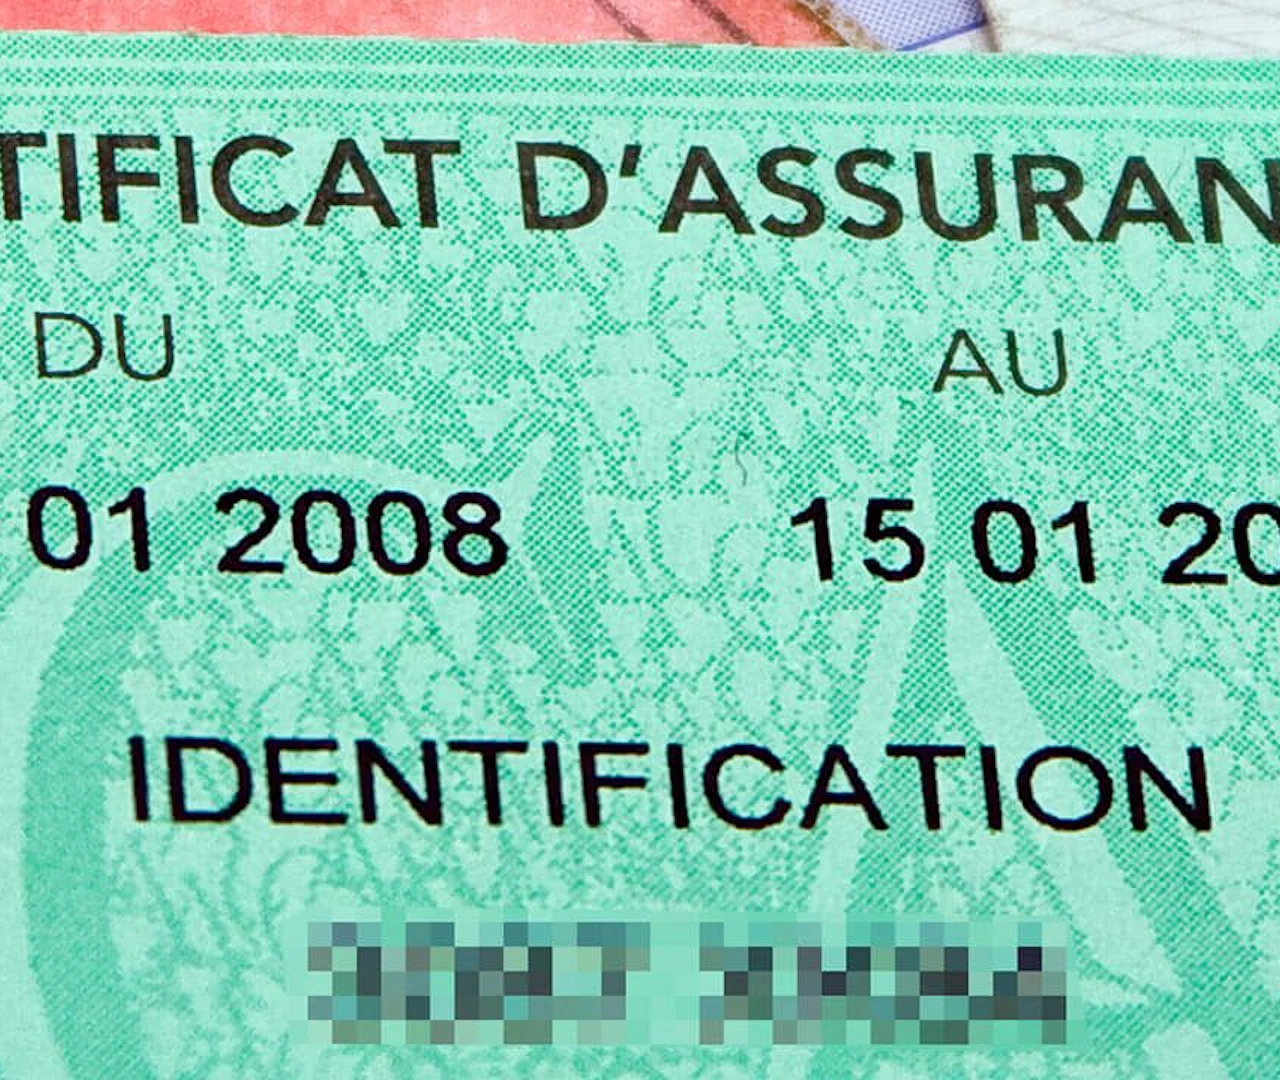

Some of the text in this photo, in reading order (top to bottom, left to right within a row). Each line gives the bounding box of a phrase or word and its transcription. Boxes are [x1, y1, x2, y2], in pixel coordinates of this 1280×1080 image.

[28, 305, 182, 386] DU
[928, 324, 1074, 400] AU
[25, 484, 154, 574] 01
[212, 485, 511, 580] 2008
[789, 492, 926, 584] 15
[969, 496, 1098, 588] 01
[126, 733, 1213, 834] IDENTIFICATION
